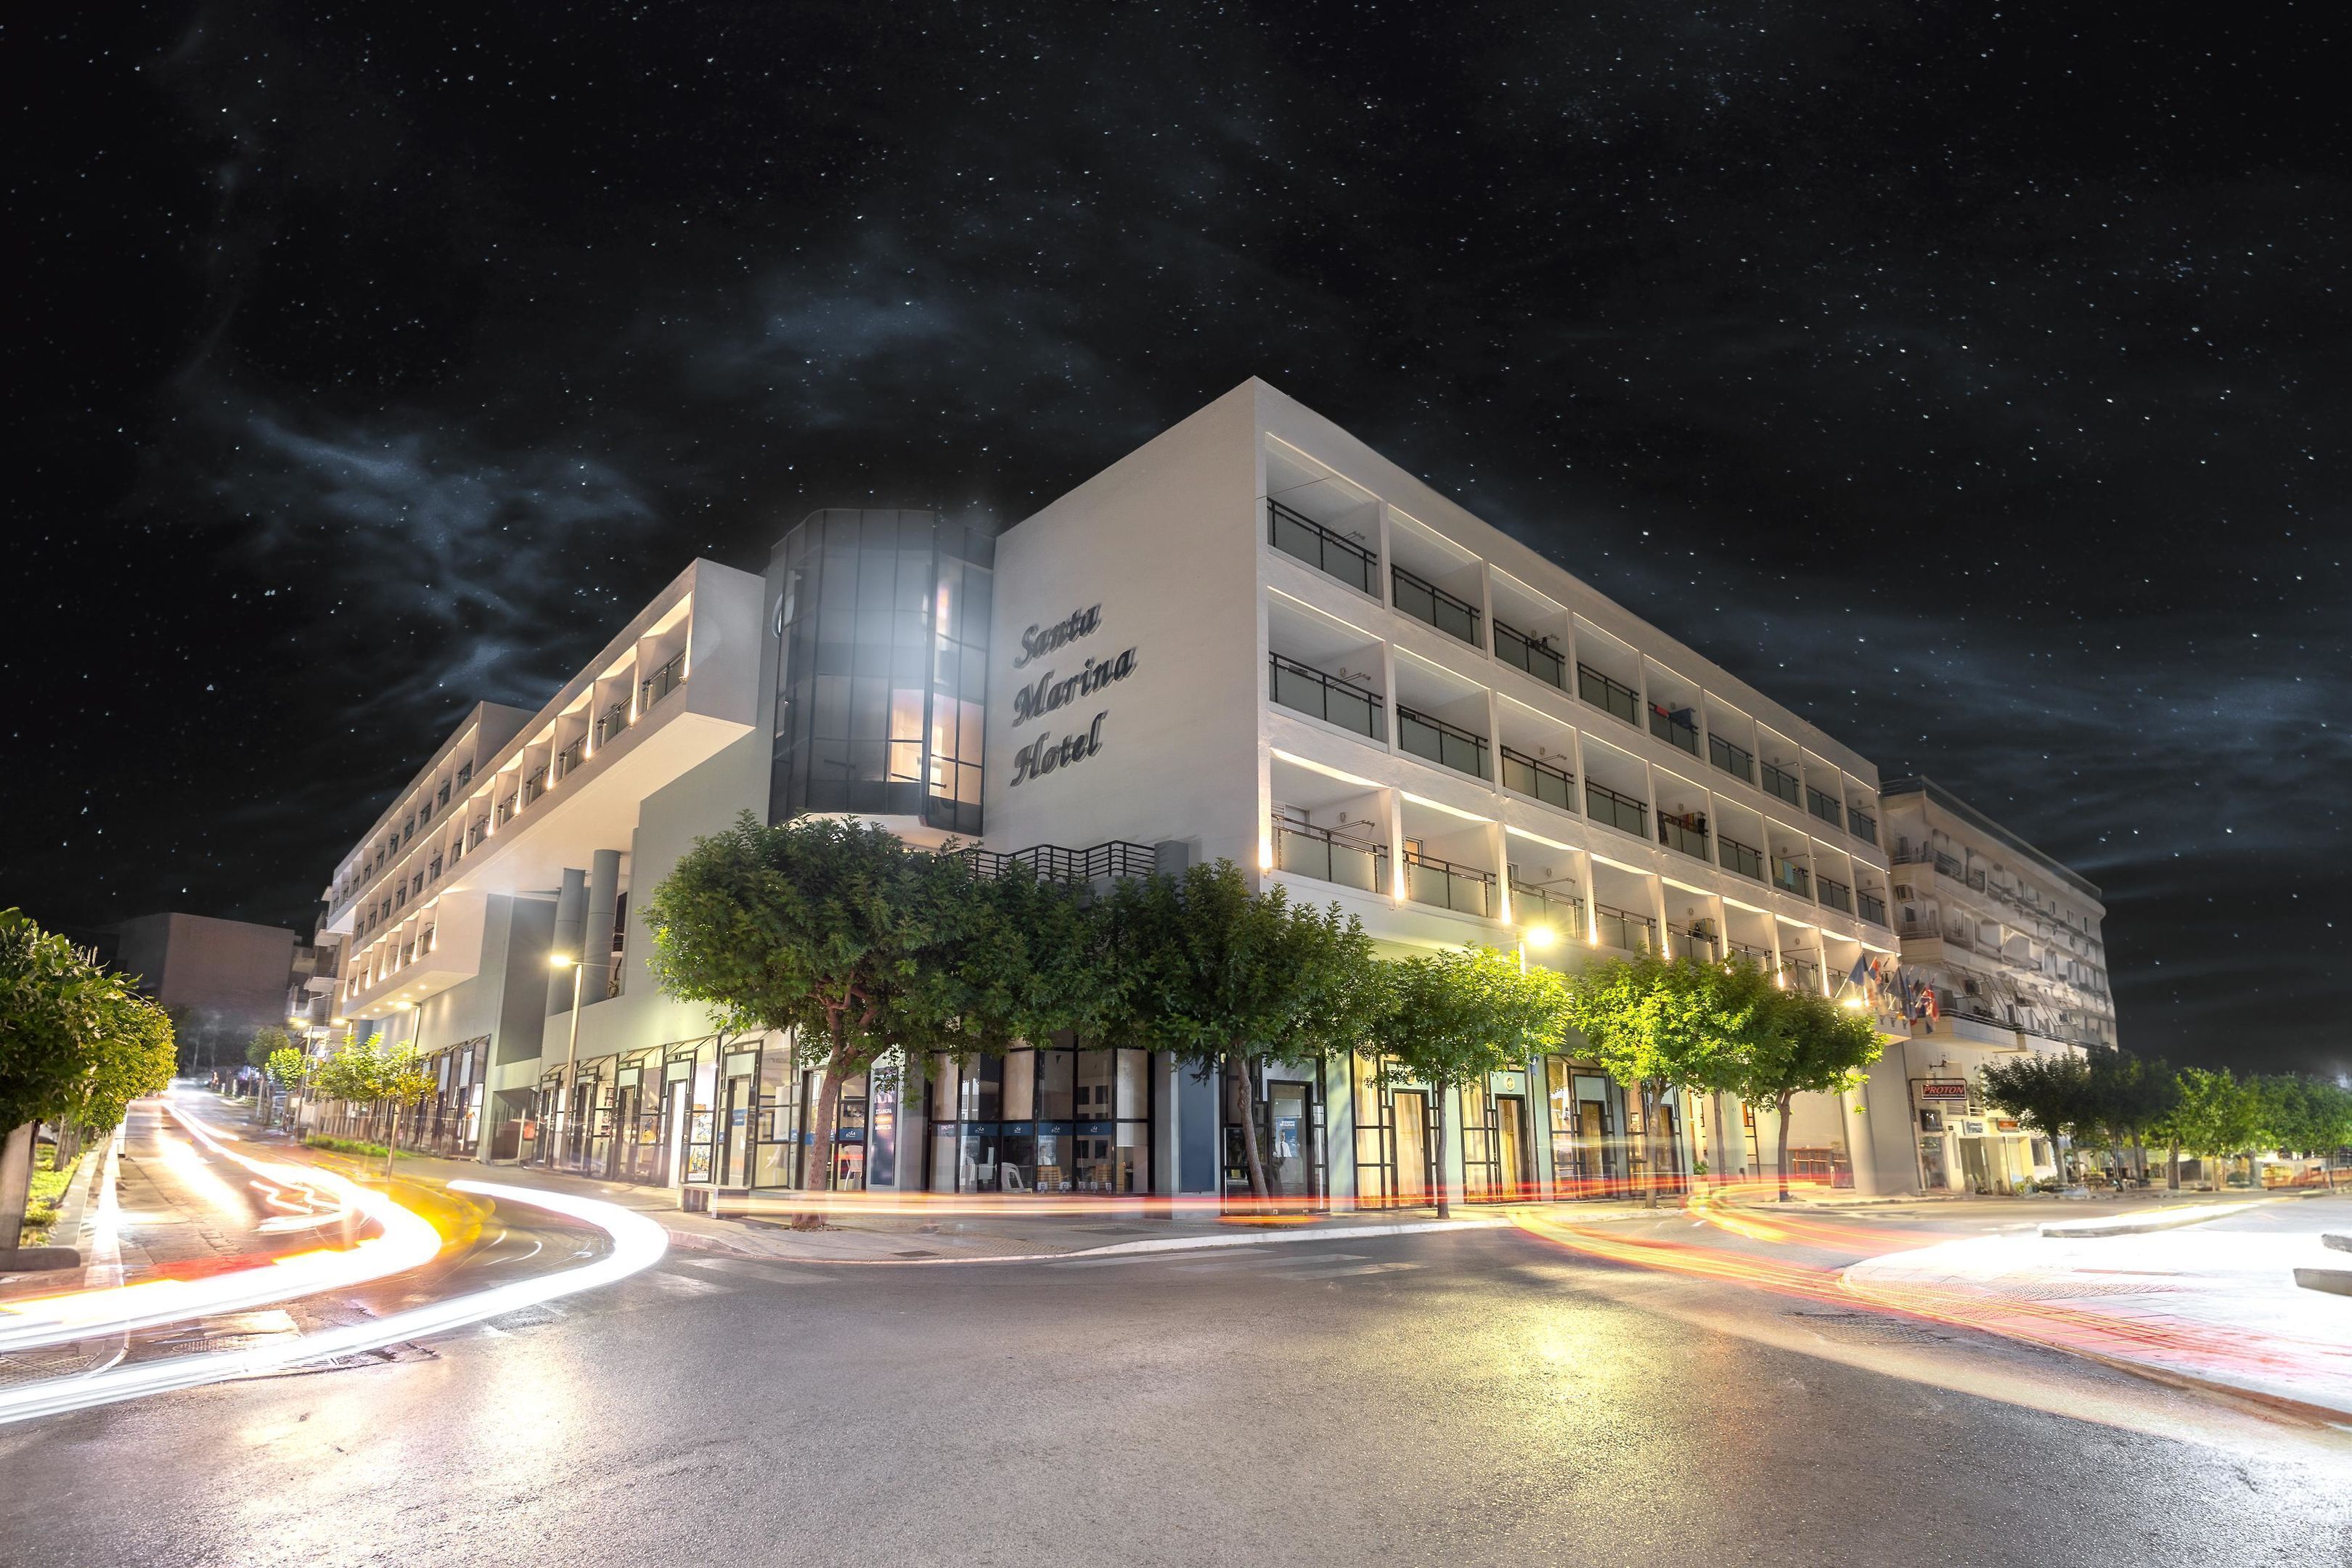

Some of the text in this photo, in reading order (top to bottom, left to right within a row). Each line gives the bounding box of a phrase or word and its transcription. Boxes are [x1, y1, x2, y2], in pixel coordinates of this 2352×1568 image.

[1014, 604, 1101, 669] Santa
[1012, 647, 1137, 727] Marina
[1010, 710, 1108, 786] Hotel
